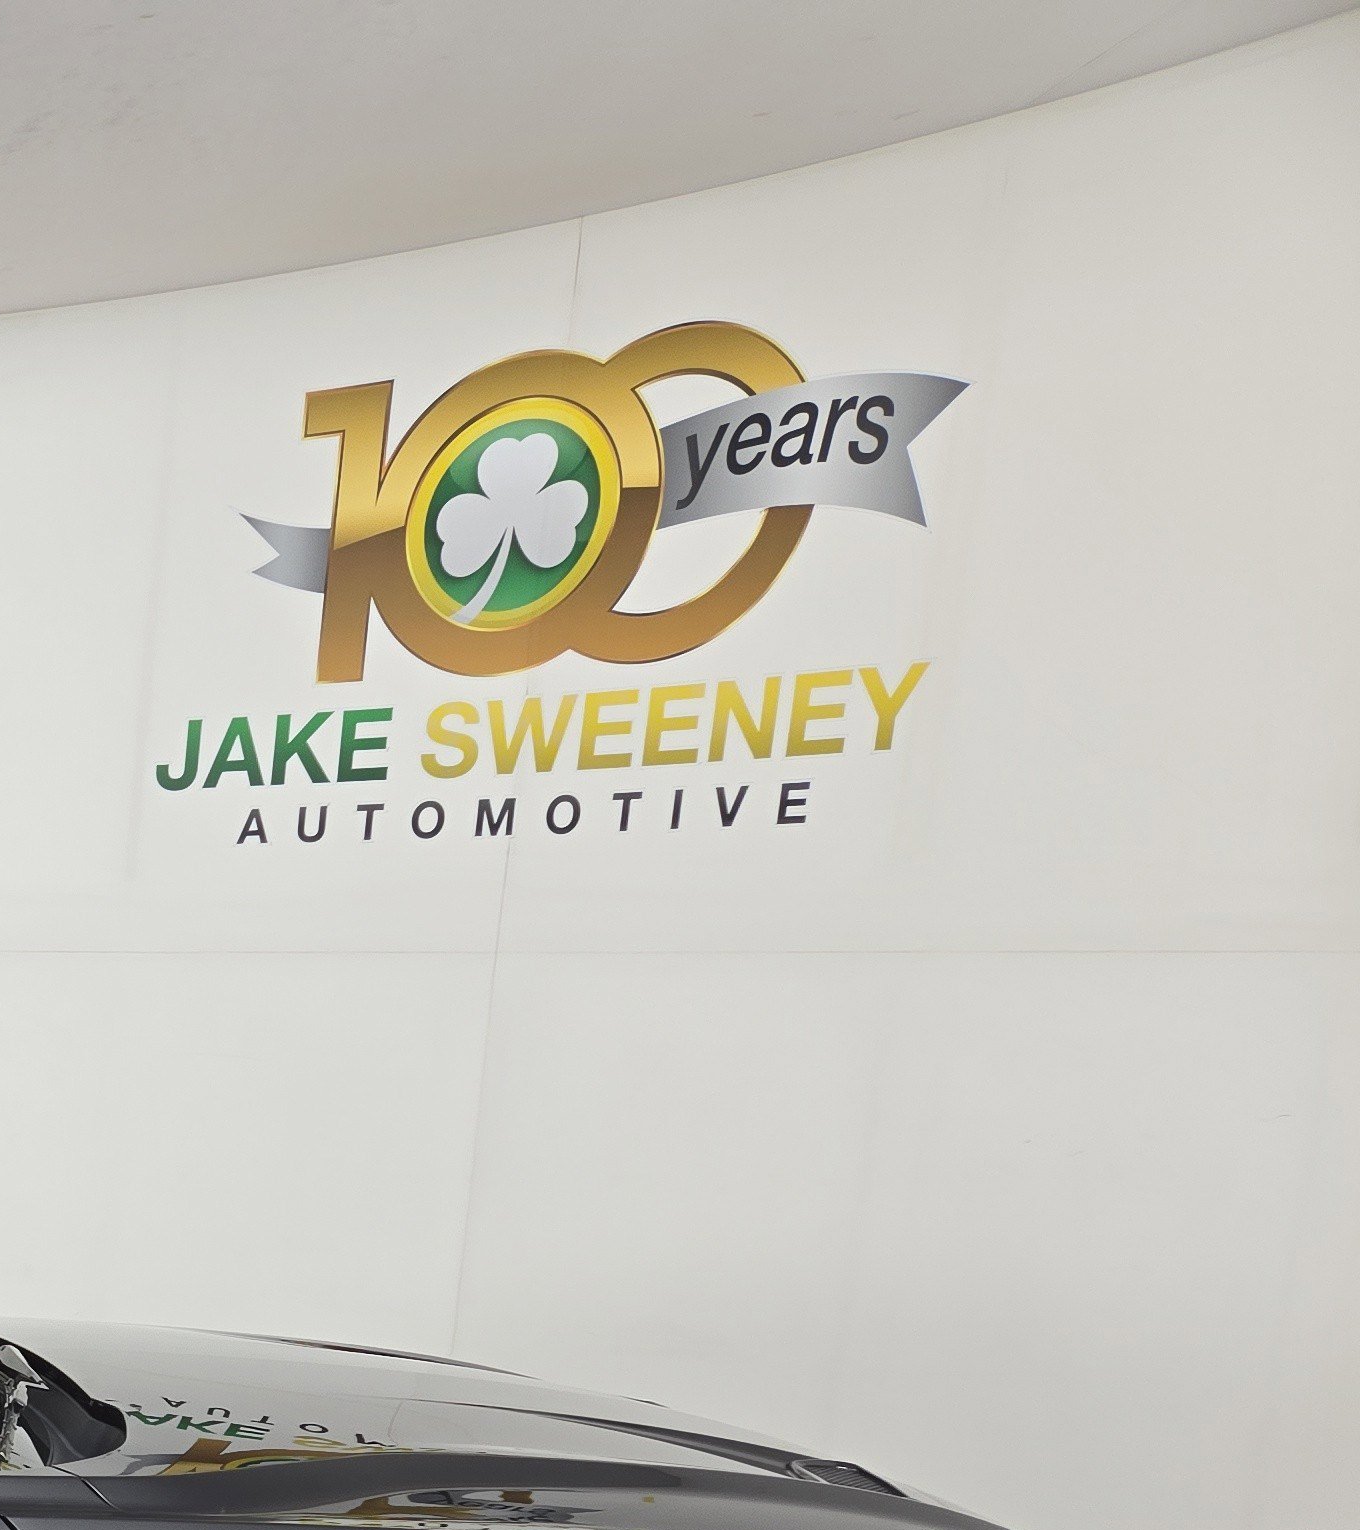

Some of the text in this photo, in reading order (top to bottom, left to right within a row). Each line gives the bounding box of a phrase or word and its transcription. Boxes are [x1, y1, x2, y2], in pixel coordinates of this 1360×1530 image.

[303, 320, 895, 685] 100 years
[156, 663, 928, 792] JAKE SWEENEY
[237, 783, 812, 845] AUTOMOTIVE
